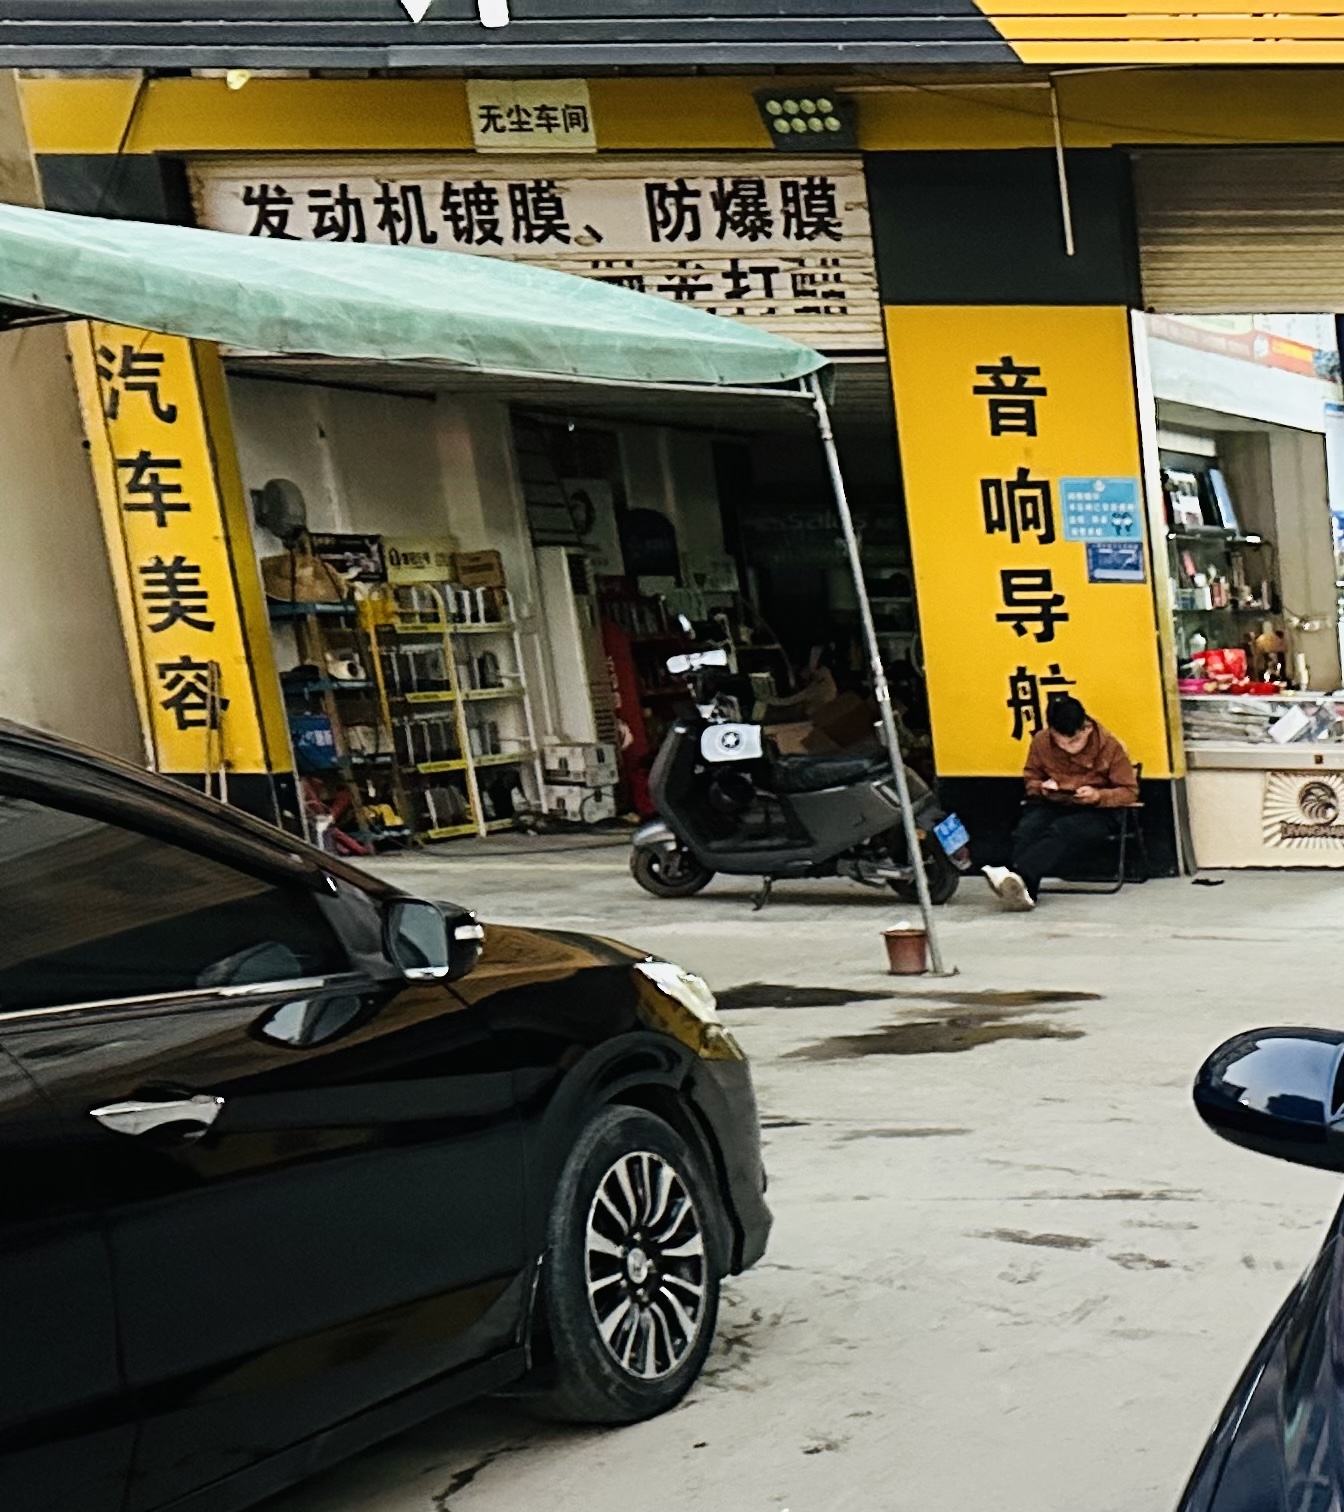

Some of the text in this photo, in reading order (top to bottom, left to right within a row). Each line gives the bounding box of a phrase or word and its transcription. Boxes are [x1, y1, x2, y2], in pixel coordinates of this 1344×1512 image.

[479, 104, 589, 133] 无尘车间
[96, 344, 230, 732] 汽车美容
[972, 355, 1077, 741] 音响导航
